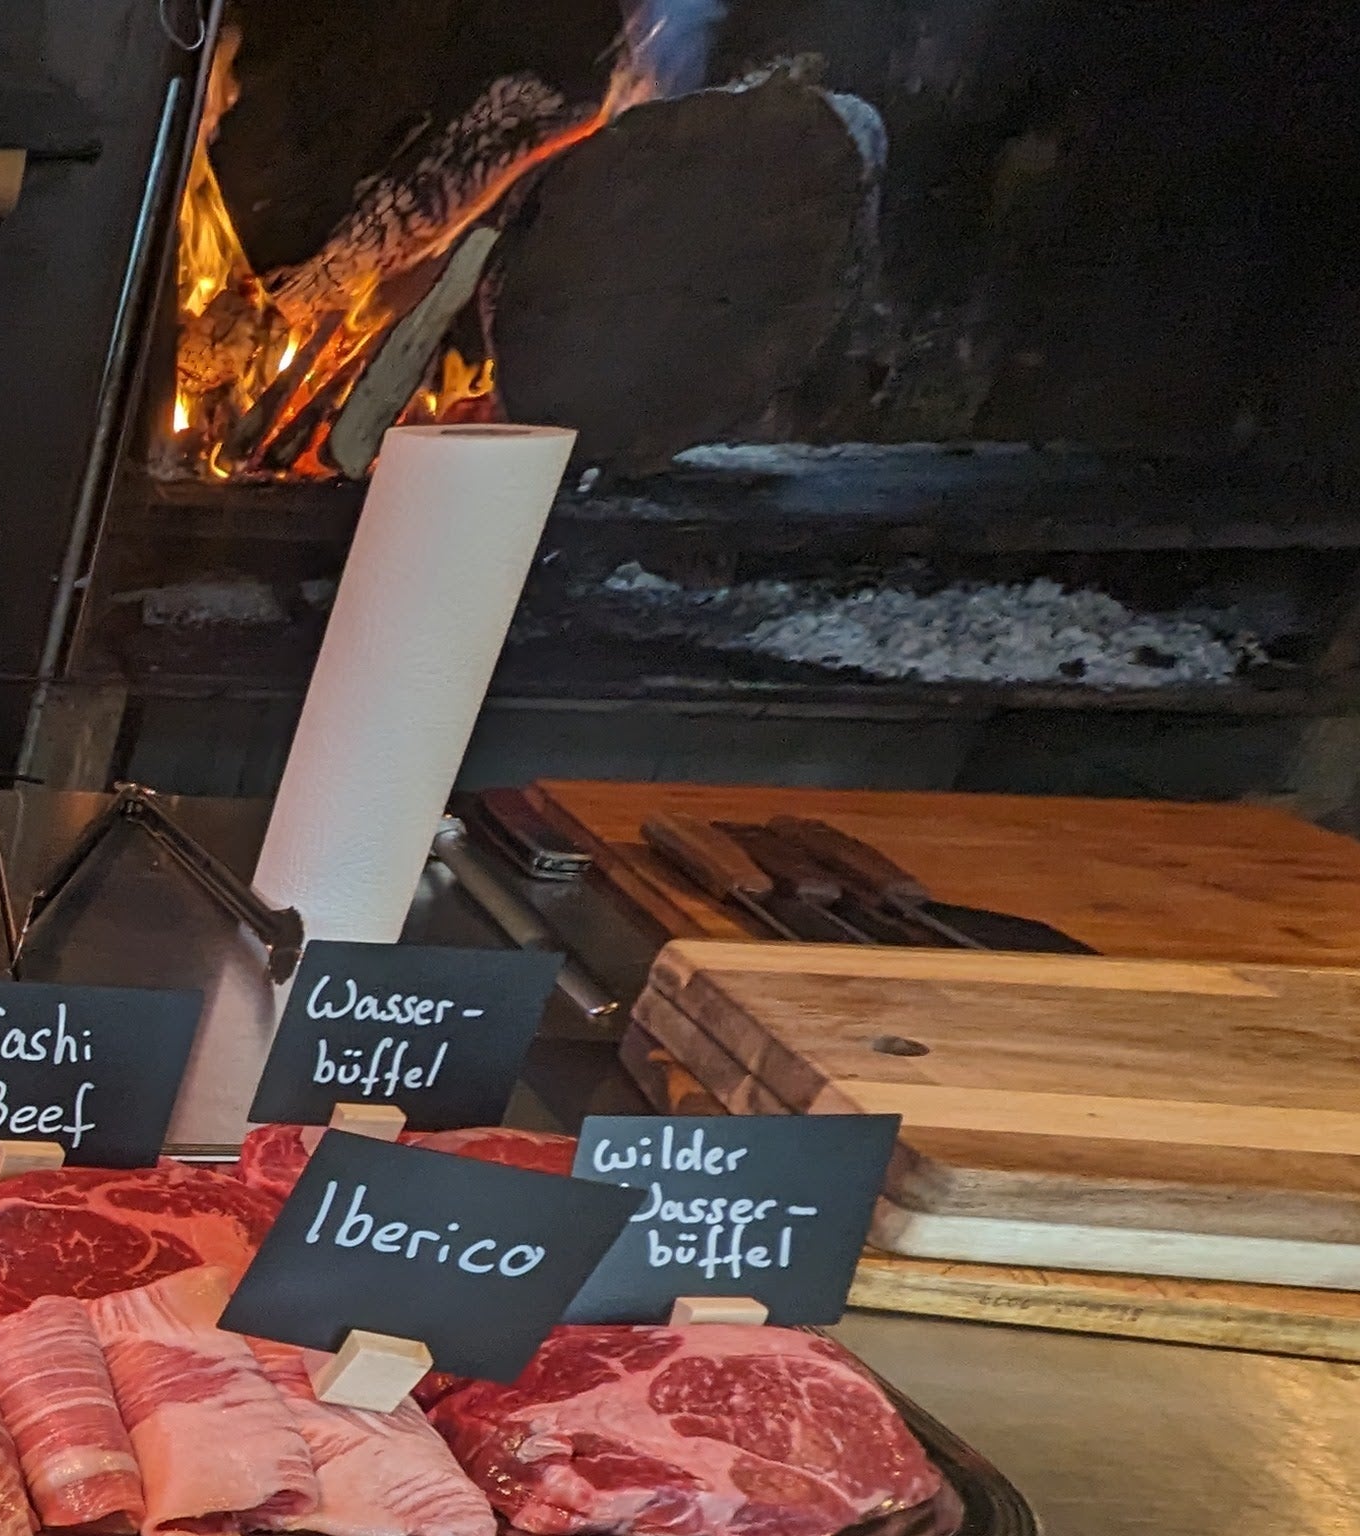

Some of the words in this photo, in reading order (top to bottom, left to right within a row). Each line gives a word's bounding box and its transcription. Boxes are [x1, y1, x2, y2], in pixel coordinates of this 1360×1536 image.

[306, 975, 484, 1026] Wasser-
[313, 1036, 449, 1097] büffel
[593, 1125, 748, 1175] wilder
[305, 1180, 545, 1277] Iberico
[648, 1224, 792, 1279] büffel
